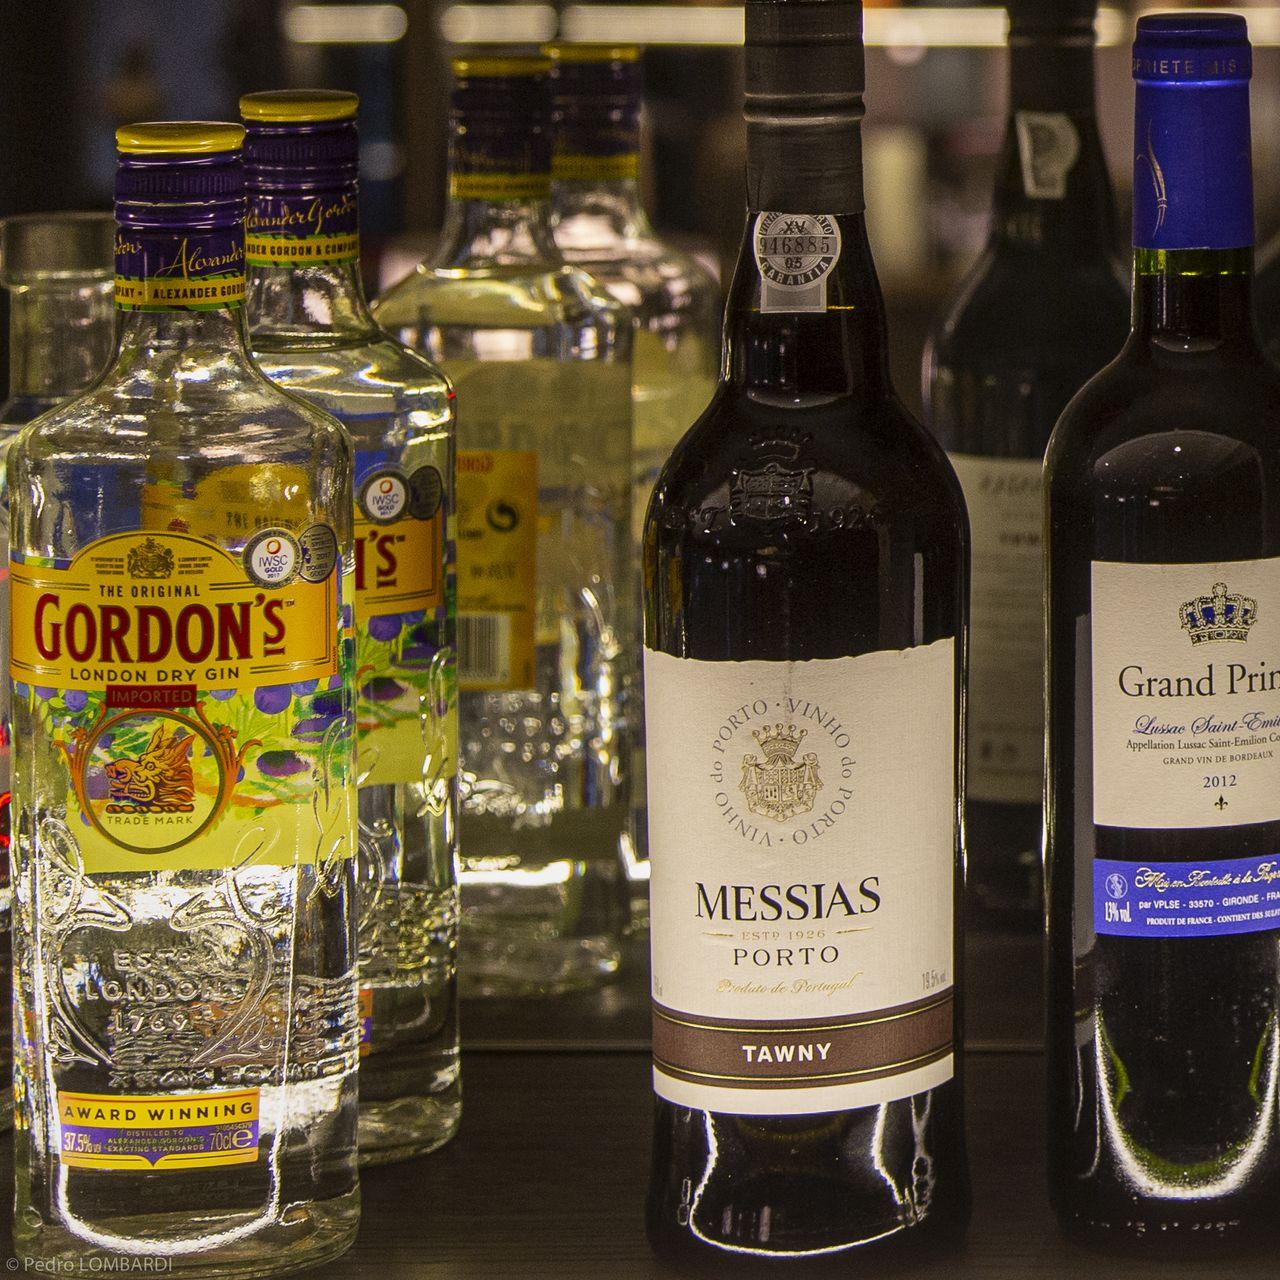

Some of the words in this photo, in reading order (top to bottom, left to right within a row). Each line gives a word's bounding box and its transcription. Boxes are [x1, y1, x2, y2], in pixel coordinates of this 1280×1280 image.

[270, 245, 312, 257] GORDON
[759, 236, 831, 255] 946885
[761, 261, 830, 285] GARANTIA
[152, 286, 218, 300] ALEXANDER
[259, 554, 289, 567] IWSC
[264, 565, 284, 574] GOLD
[99, 584, 126, 598] THE
[131, 584, 201, 598] ORIGINAL
[34, 592, 287, 665] GORDON'S
[70, 667, 147, 682] LONDON
[156, 668, 197, 682] DRY
[205, 667, 240, 681] GIN
[1118, 663, 1217, 699] Grand
[112, 689, 192, 703] IMPORTED
[712, 699, 768, 754] PORTO
[788, 697, 851, 749] VINHO
[1132, 714, 1186, 736] Lussac
[1126, 738, 1175, 752] Appellation
[1177, 739, 1207, 751] Lussac
[1208, 735, 1268, 750] Saint-Emilion
[1162, 756, 1195, 765] GRAND
[1196, 755, 1213, 764] VIN
[1215, 754, 1228, 764] DE
[1229, 750, 1275, 763] BORDEAUX
[1202, 774, 1238, 789] 2012
[106, 815, 149, 826] TRADE
[155, 814, 194, 826] MARK
[714, 791, 773, 847] VINHO
[792, 787, 854, 845] PORTO
[695, 876, 882, 922] MESSIAS
[1138, 901, 1151, 911] par
[1153, 900, 1180, 910] VPLSE
[1222, 895, 1259, 907] GIRONDE
[1146, 917, 1175, 927] PRODUIT
[1176, 917, 1187, 926] DE
[1187, 915, 1213, 925] FRANCE
[1217, 913, 1251, 924] CONTIENT
[788, 929, 826, 940] 1926
[733, 945, 840, 967] PORTO
[715, 977, 768, 995] Produto
[770, 980, 787, 994] de
[742, 1041, 832, 1063] TAWNY
[64, 1105, 137, 1121] AWARD
[147, 1101, 253, 1121] WINNING
[126, 1129, 169, 1137] DISTILLED
[63, 1131, 93, 1153] 37.5%
